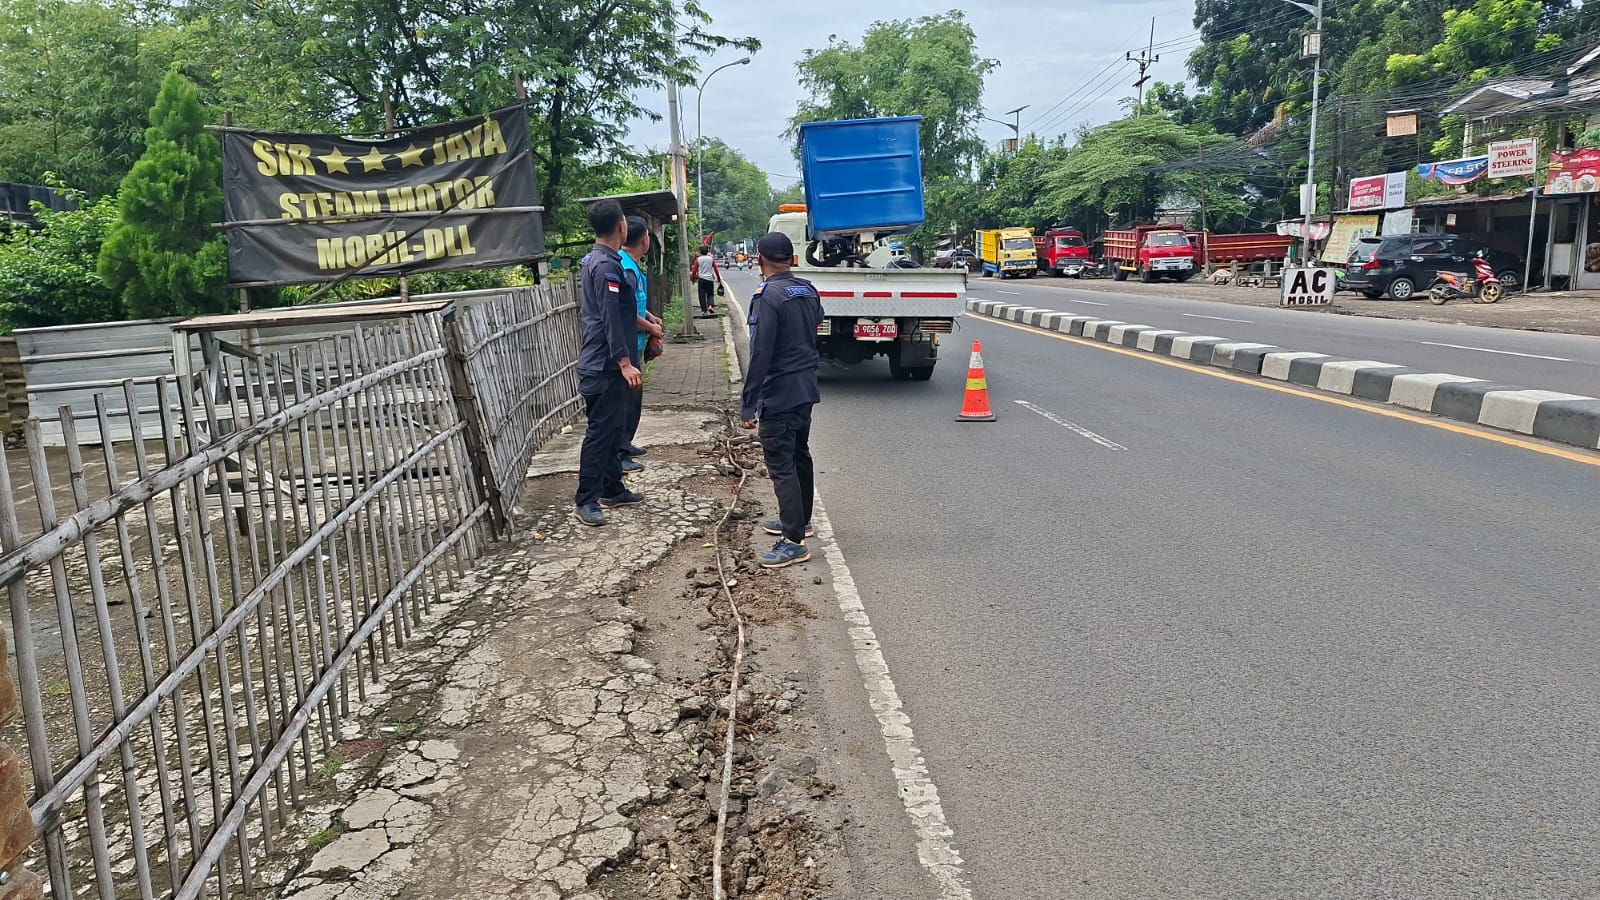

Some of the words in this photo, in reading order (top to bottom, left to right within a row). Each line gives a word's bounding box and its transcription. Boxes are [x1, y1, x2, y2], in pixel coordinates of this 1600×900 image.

[253, 139, 316, 177] SIR
[432, 120, 507, 166] JAYA
[1497, 149, 1527, 159] POWER
[1491, 158, 1533, 169] STEERING
[279, 190, 382, 225] STEAM
[386, 175, 496, 212] MOTOR
[316, 224, 477, 271] MOBIL-DLL
[1290, 270, 1327, 294] AC
[1287, 295, 1329, 305] MOBIL
